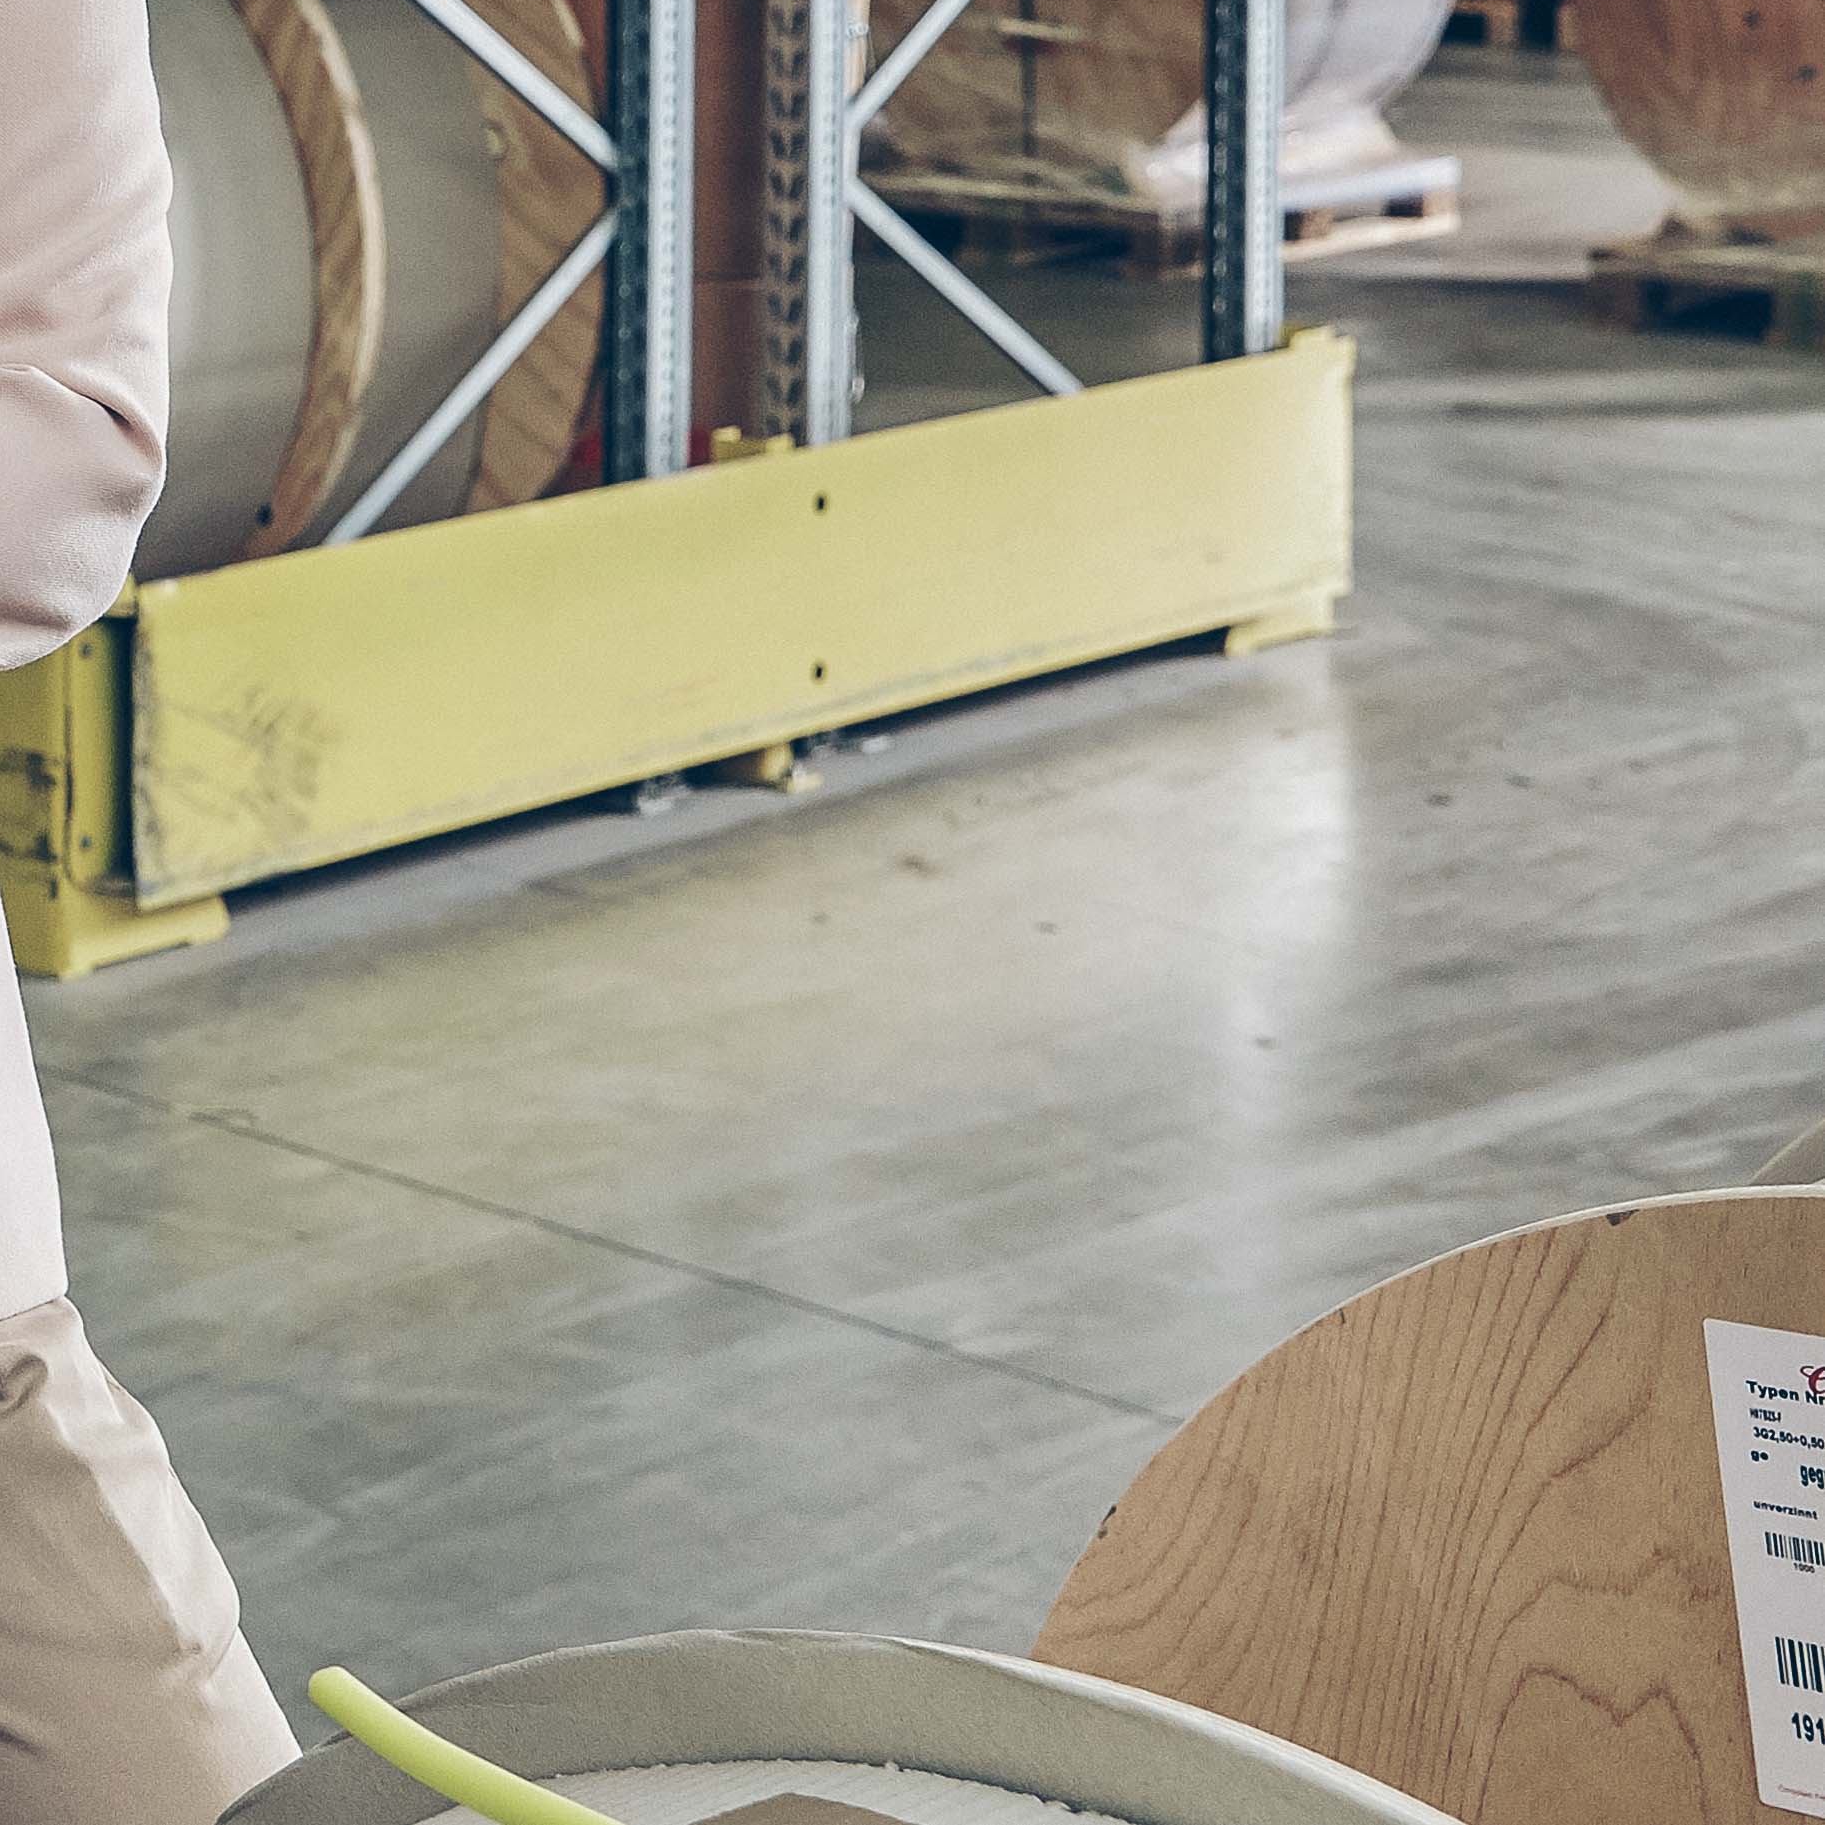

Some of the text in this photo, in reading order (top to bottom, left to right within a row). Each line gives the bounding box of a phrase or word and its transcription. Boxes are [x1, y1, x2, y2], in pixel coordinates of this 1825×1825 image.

[1745, 1379, 1799, 1402] Typen
[1800, 1464, 1825, 1490] geg
[1753, 1499, 1818, 1520] unverzinnt
